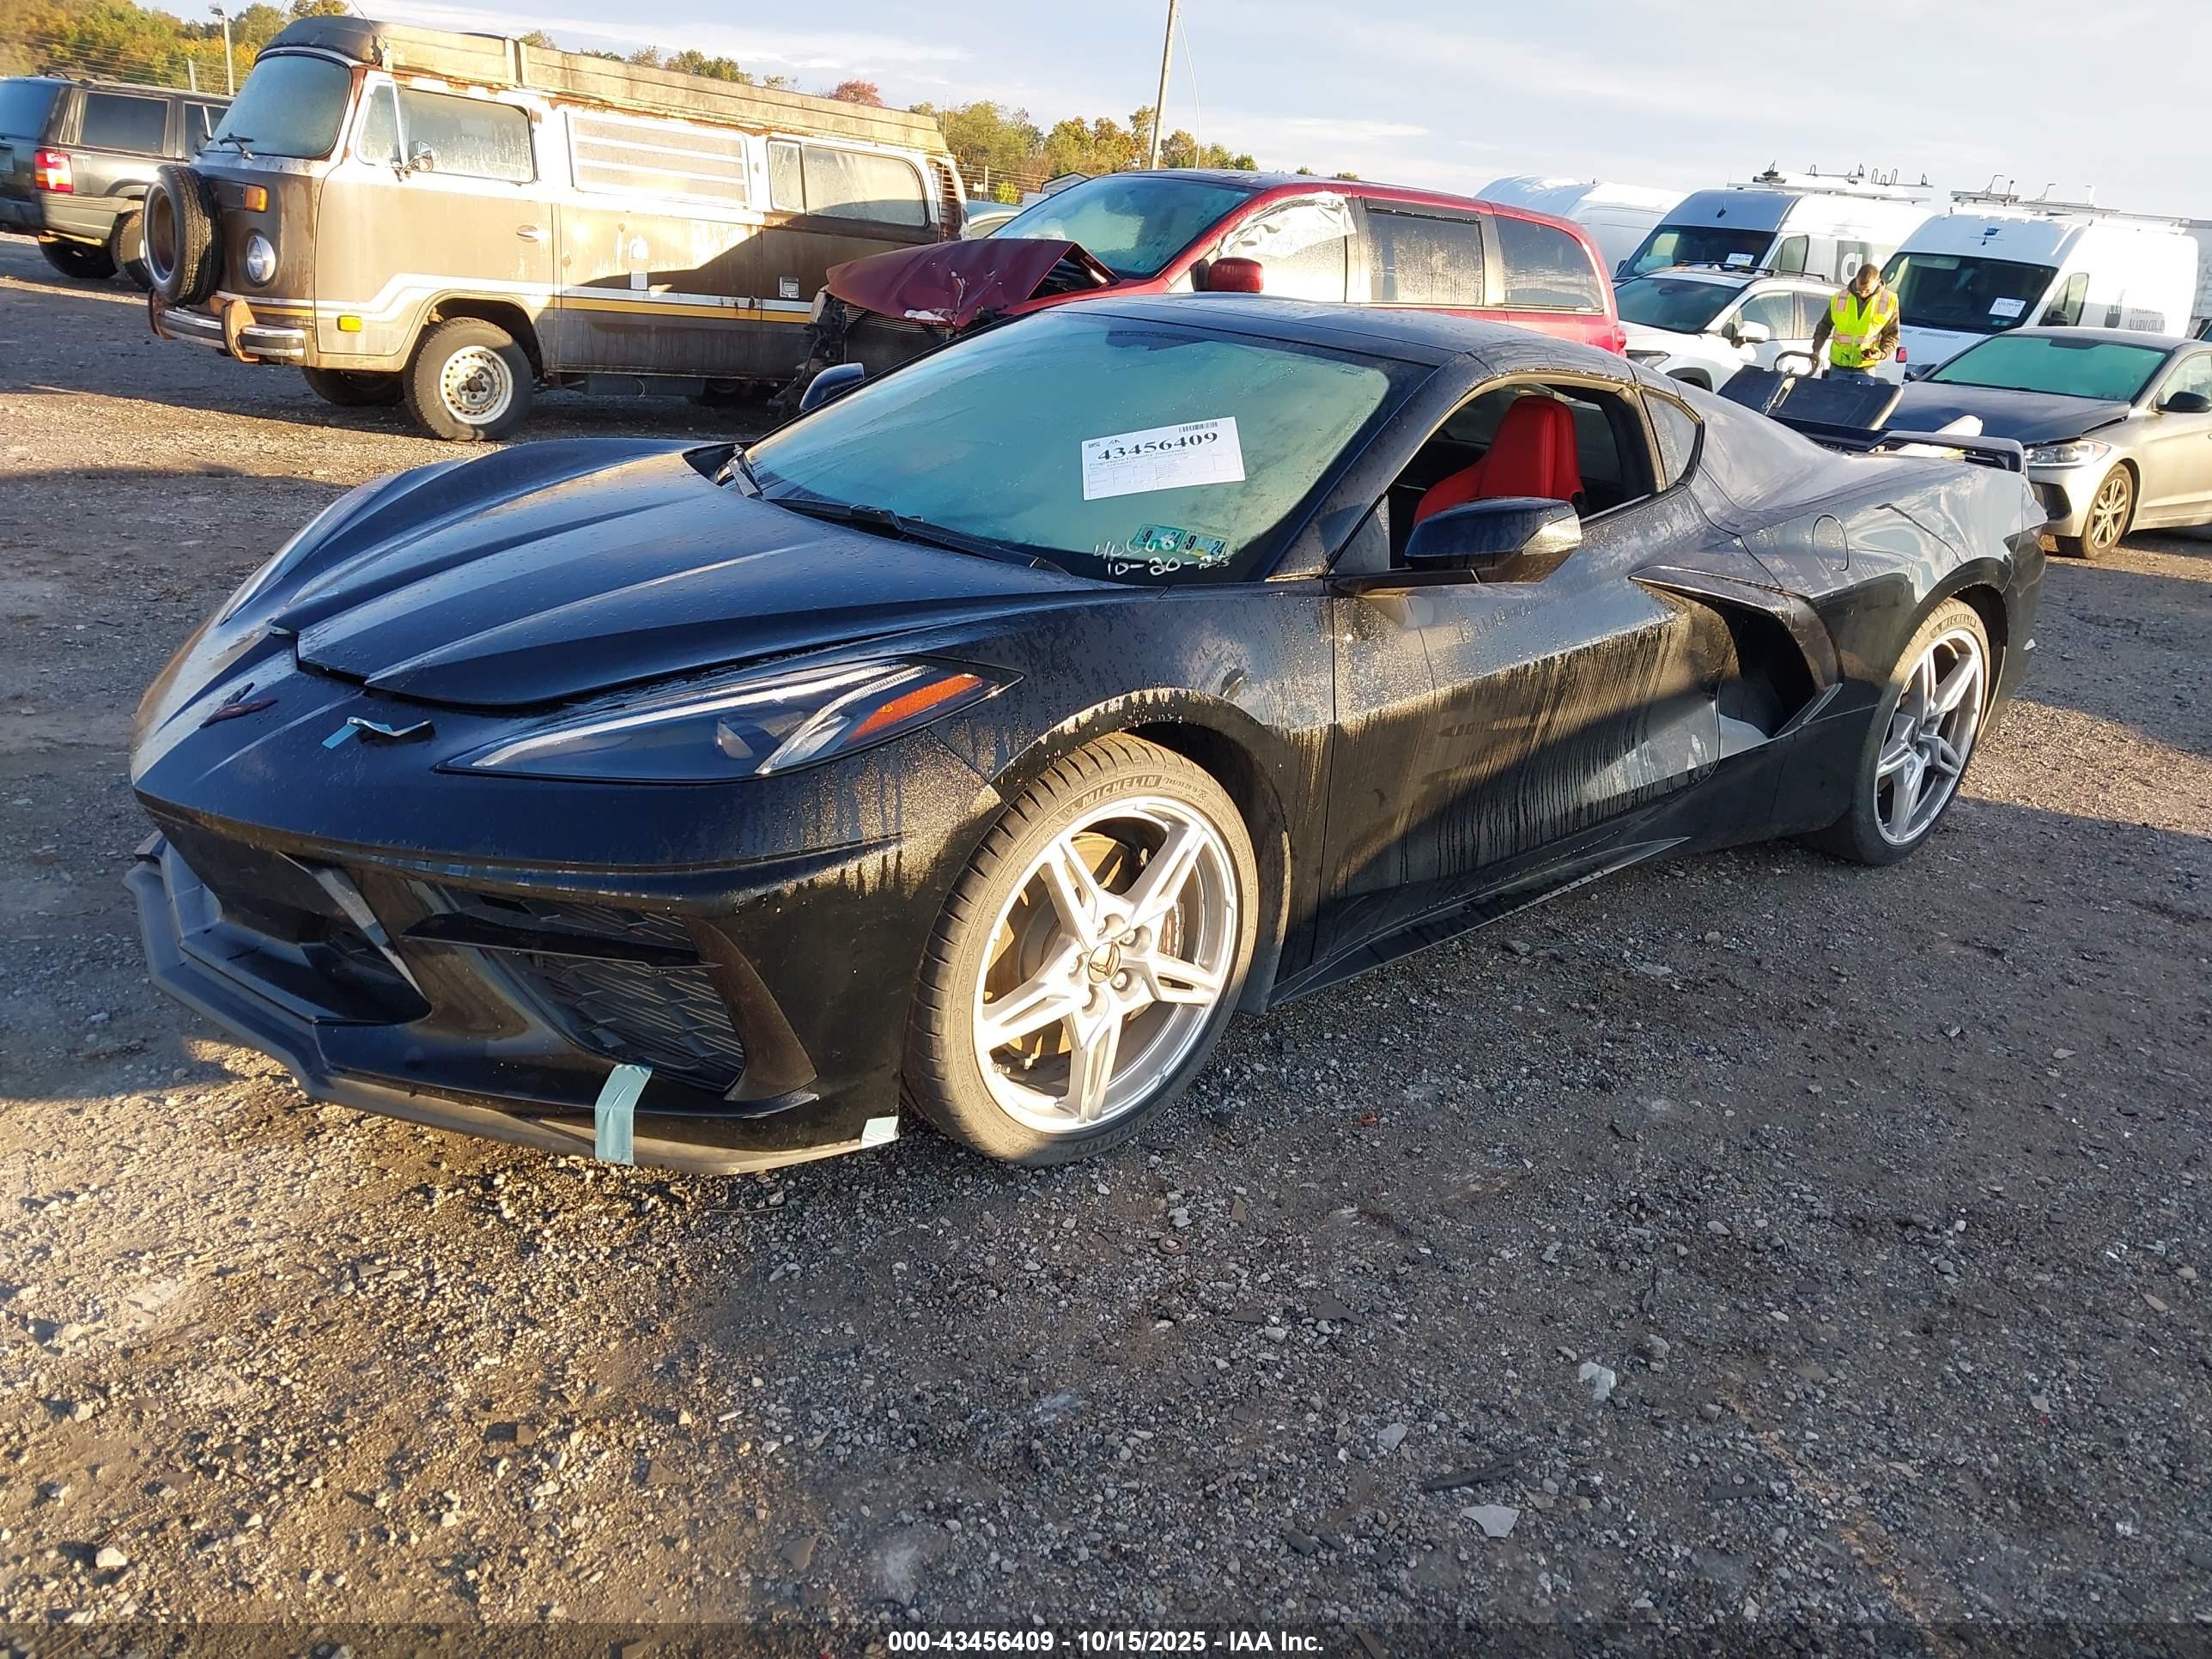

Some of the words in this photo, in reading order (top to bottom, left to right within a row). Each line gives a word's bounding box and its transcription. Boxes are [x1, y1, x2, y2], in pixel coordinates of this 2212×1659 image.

[1097, 432, 1218, 460] 43456409
[1185, 535, 1197, 550] 9
[1210, 540, 1226, 557] 24
[1082, 775, 1158, 808] MICHELIN
